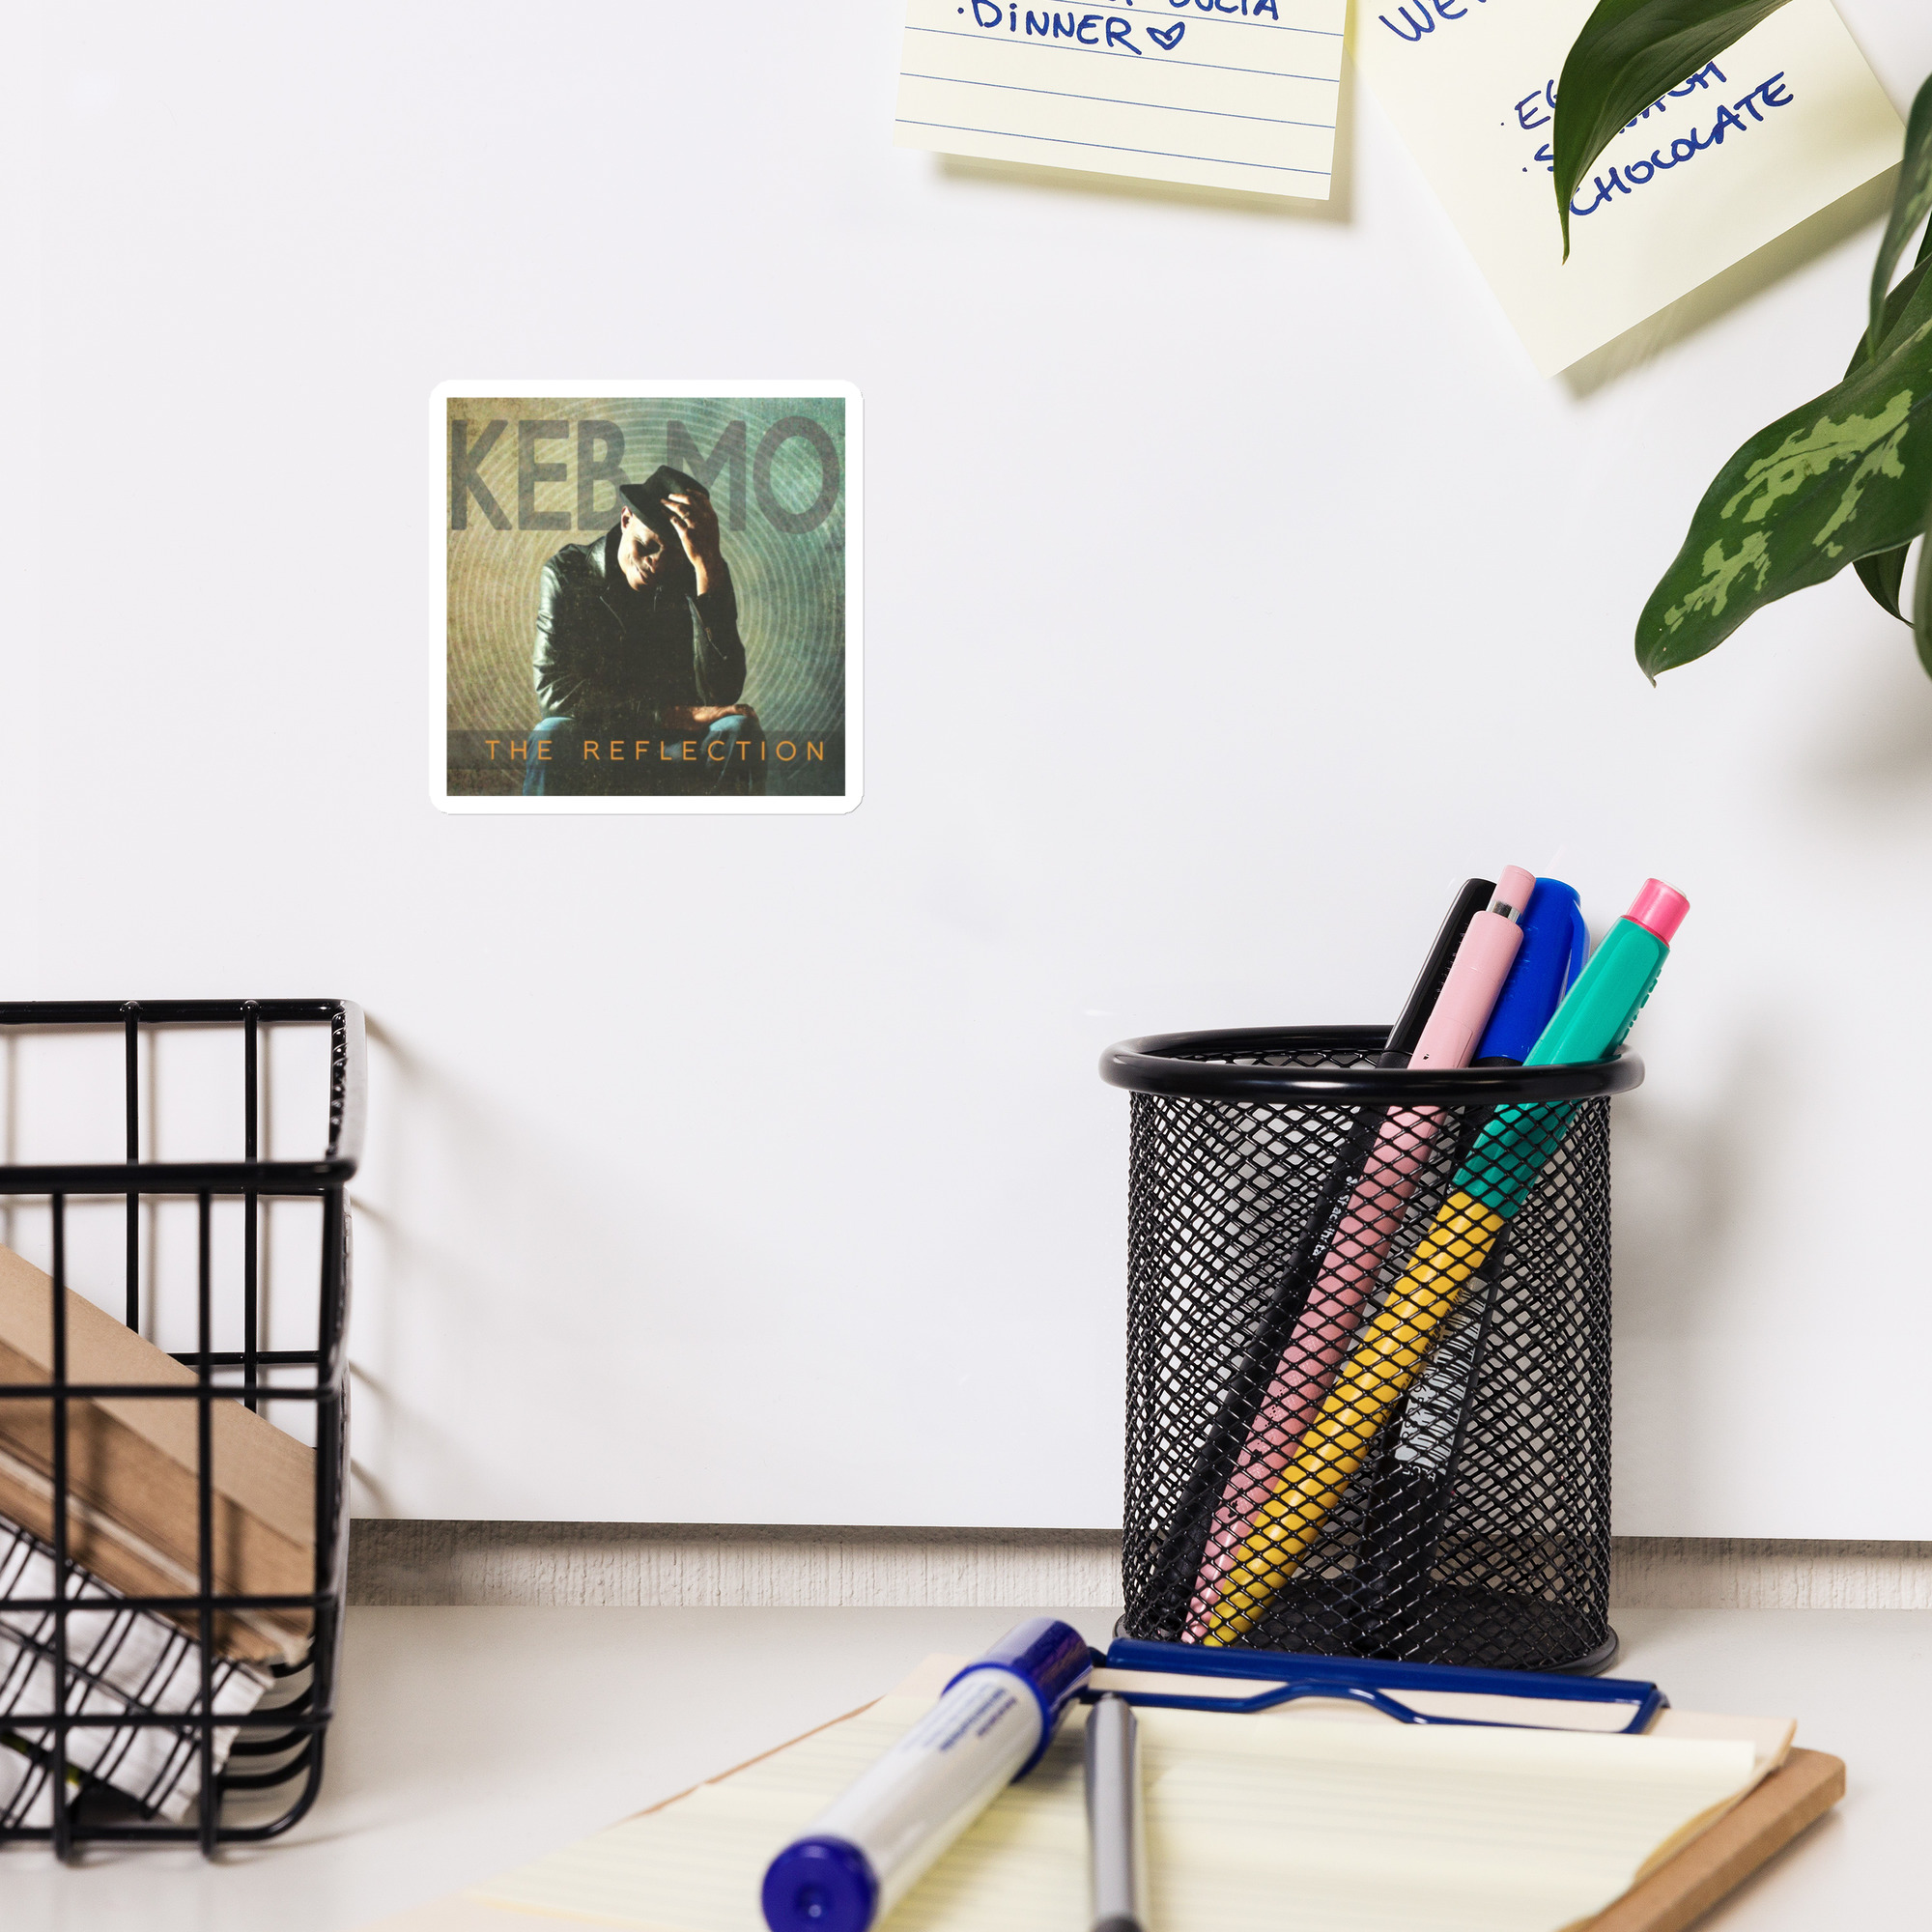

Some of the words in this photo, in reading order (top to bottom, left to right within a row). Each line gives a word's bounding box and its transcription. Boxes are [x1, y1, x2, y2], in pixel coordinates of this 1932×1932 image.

[1570, 71, 1794, 216] CHOCOLATE
[451, 419, 632, 531] KEB
[667, 415, 840, 534] MO
[485, 740, 553, 760] THE
[583, 740, 824, 761] REFLECTION
